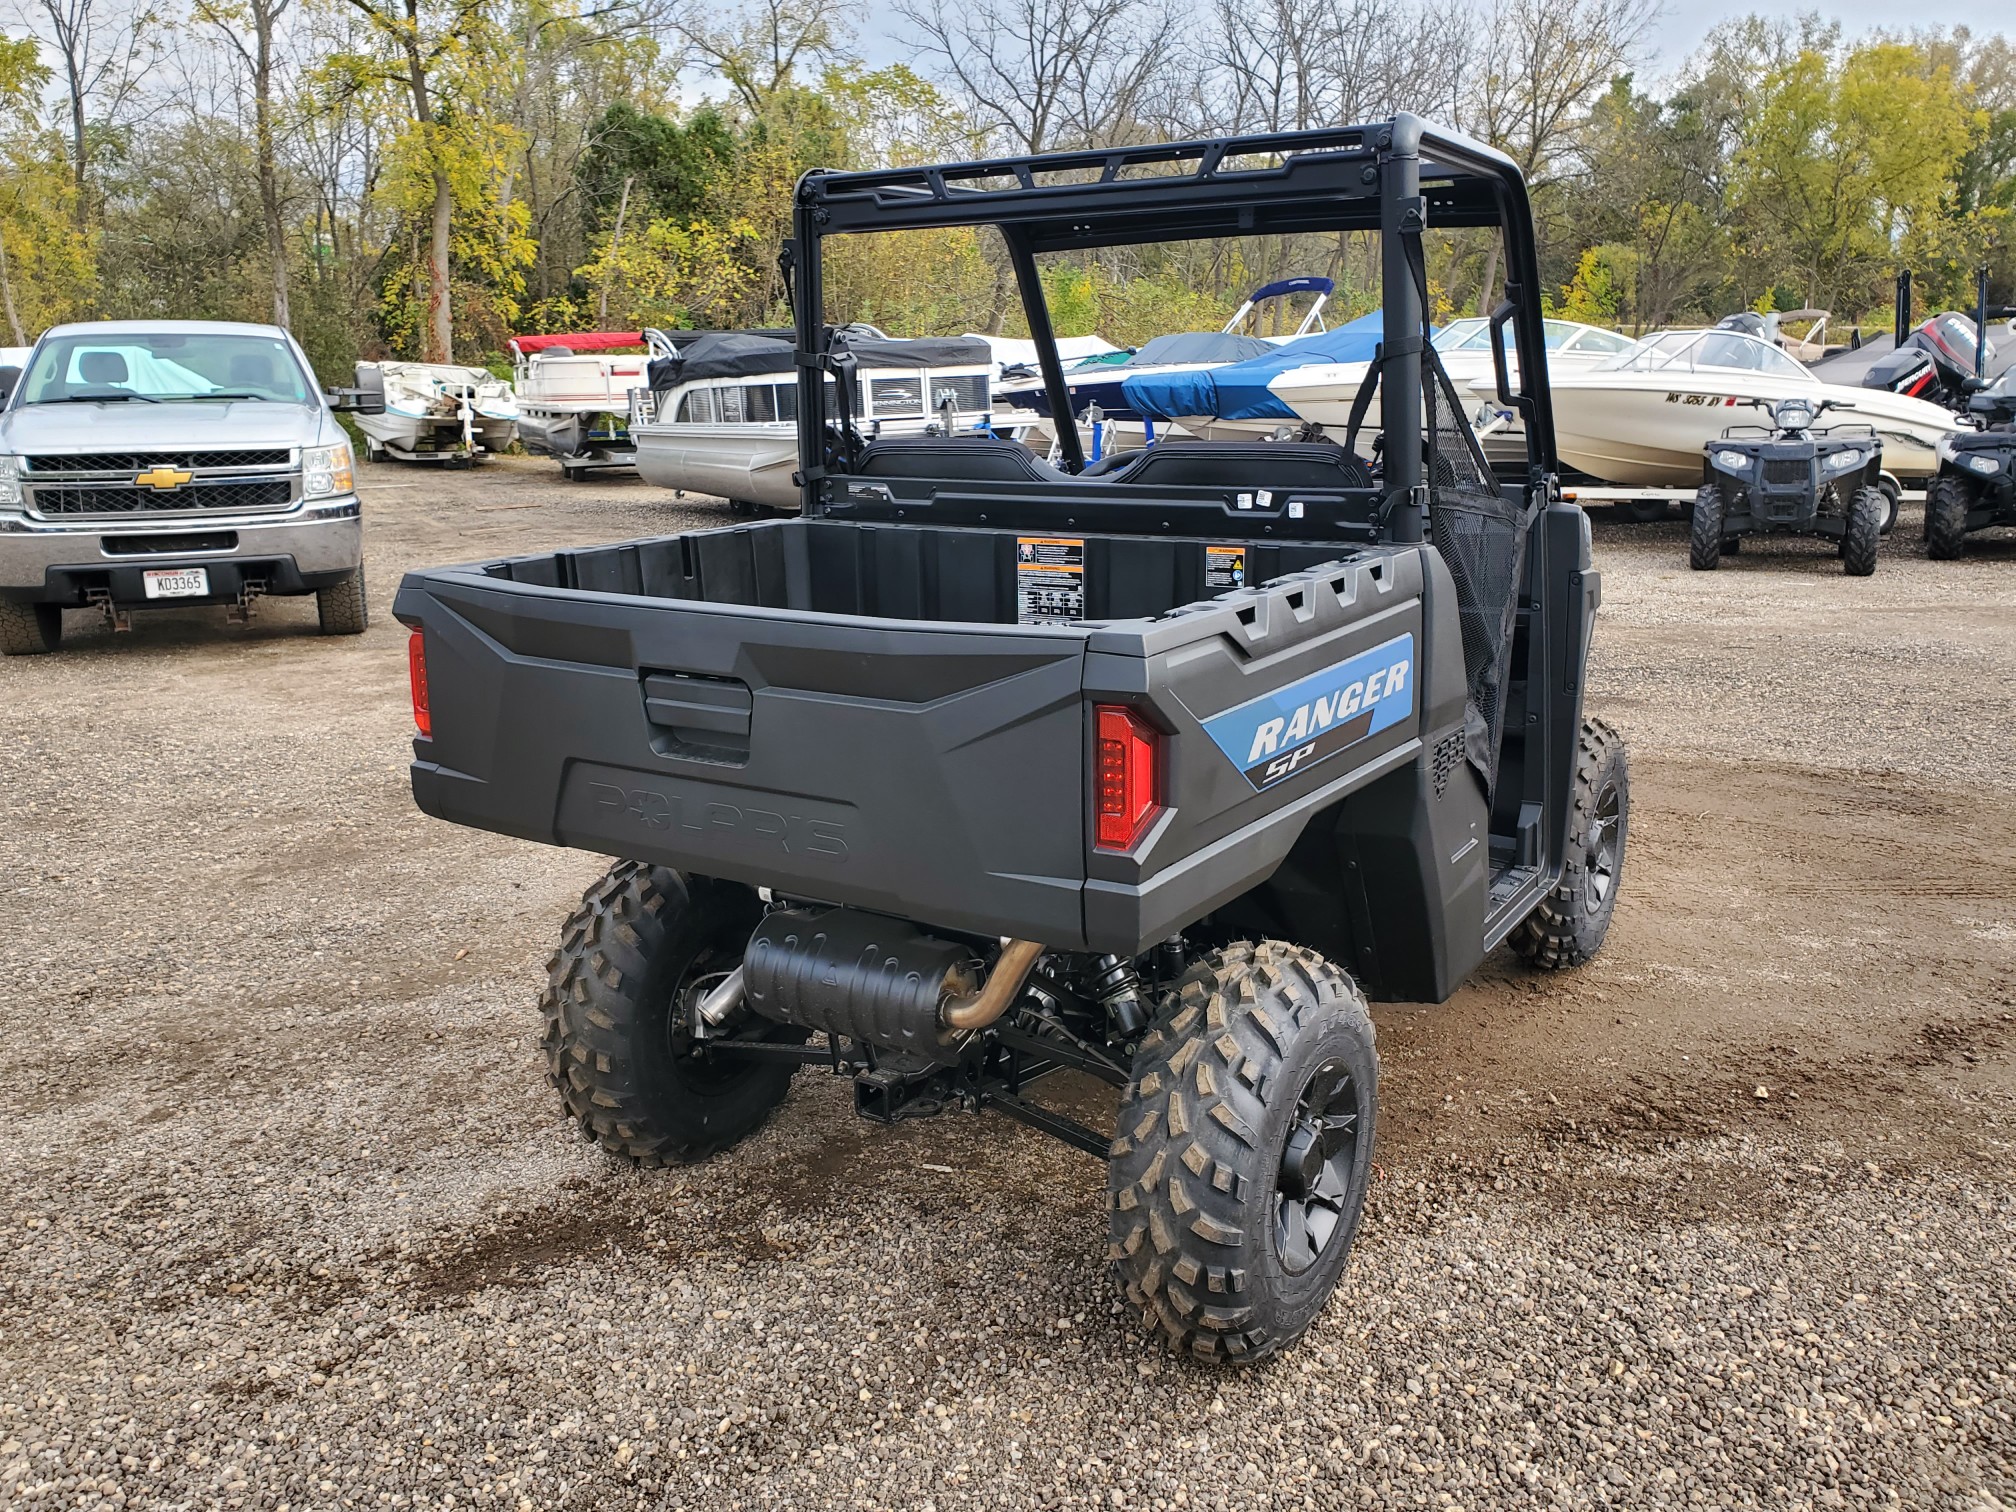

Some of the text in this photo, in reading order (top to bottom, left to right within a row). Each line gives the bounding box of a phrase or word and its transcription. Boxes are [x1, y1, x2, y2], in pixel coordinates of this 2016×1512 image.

[156, 576, 201, 591] KD3365
[1247, 659, 1410, 763] RANGER
[1262, 741, 1316, 784] SP
[587, 780, 849, 864] POLARIS
